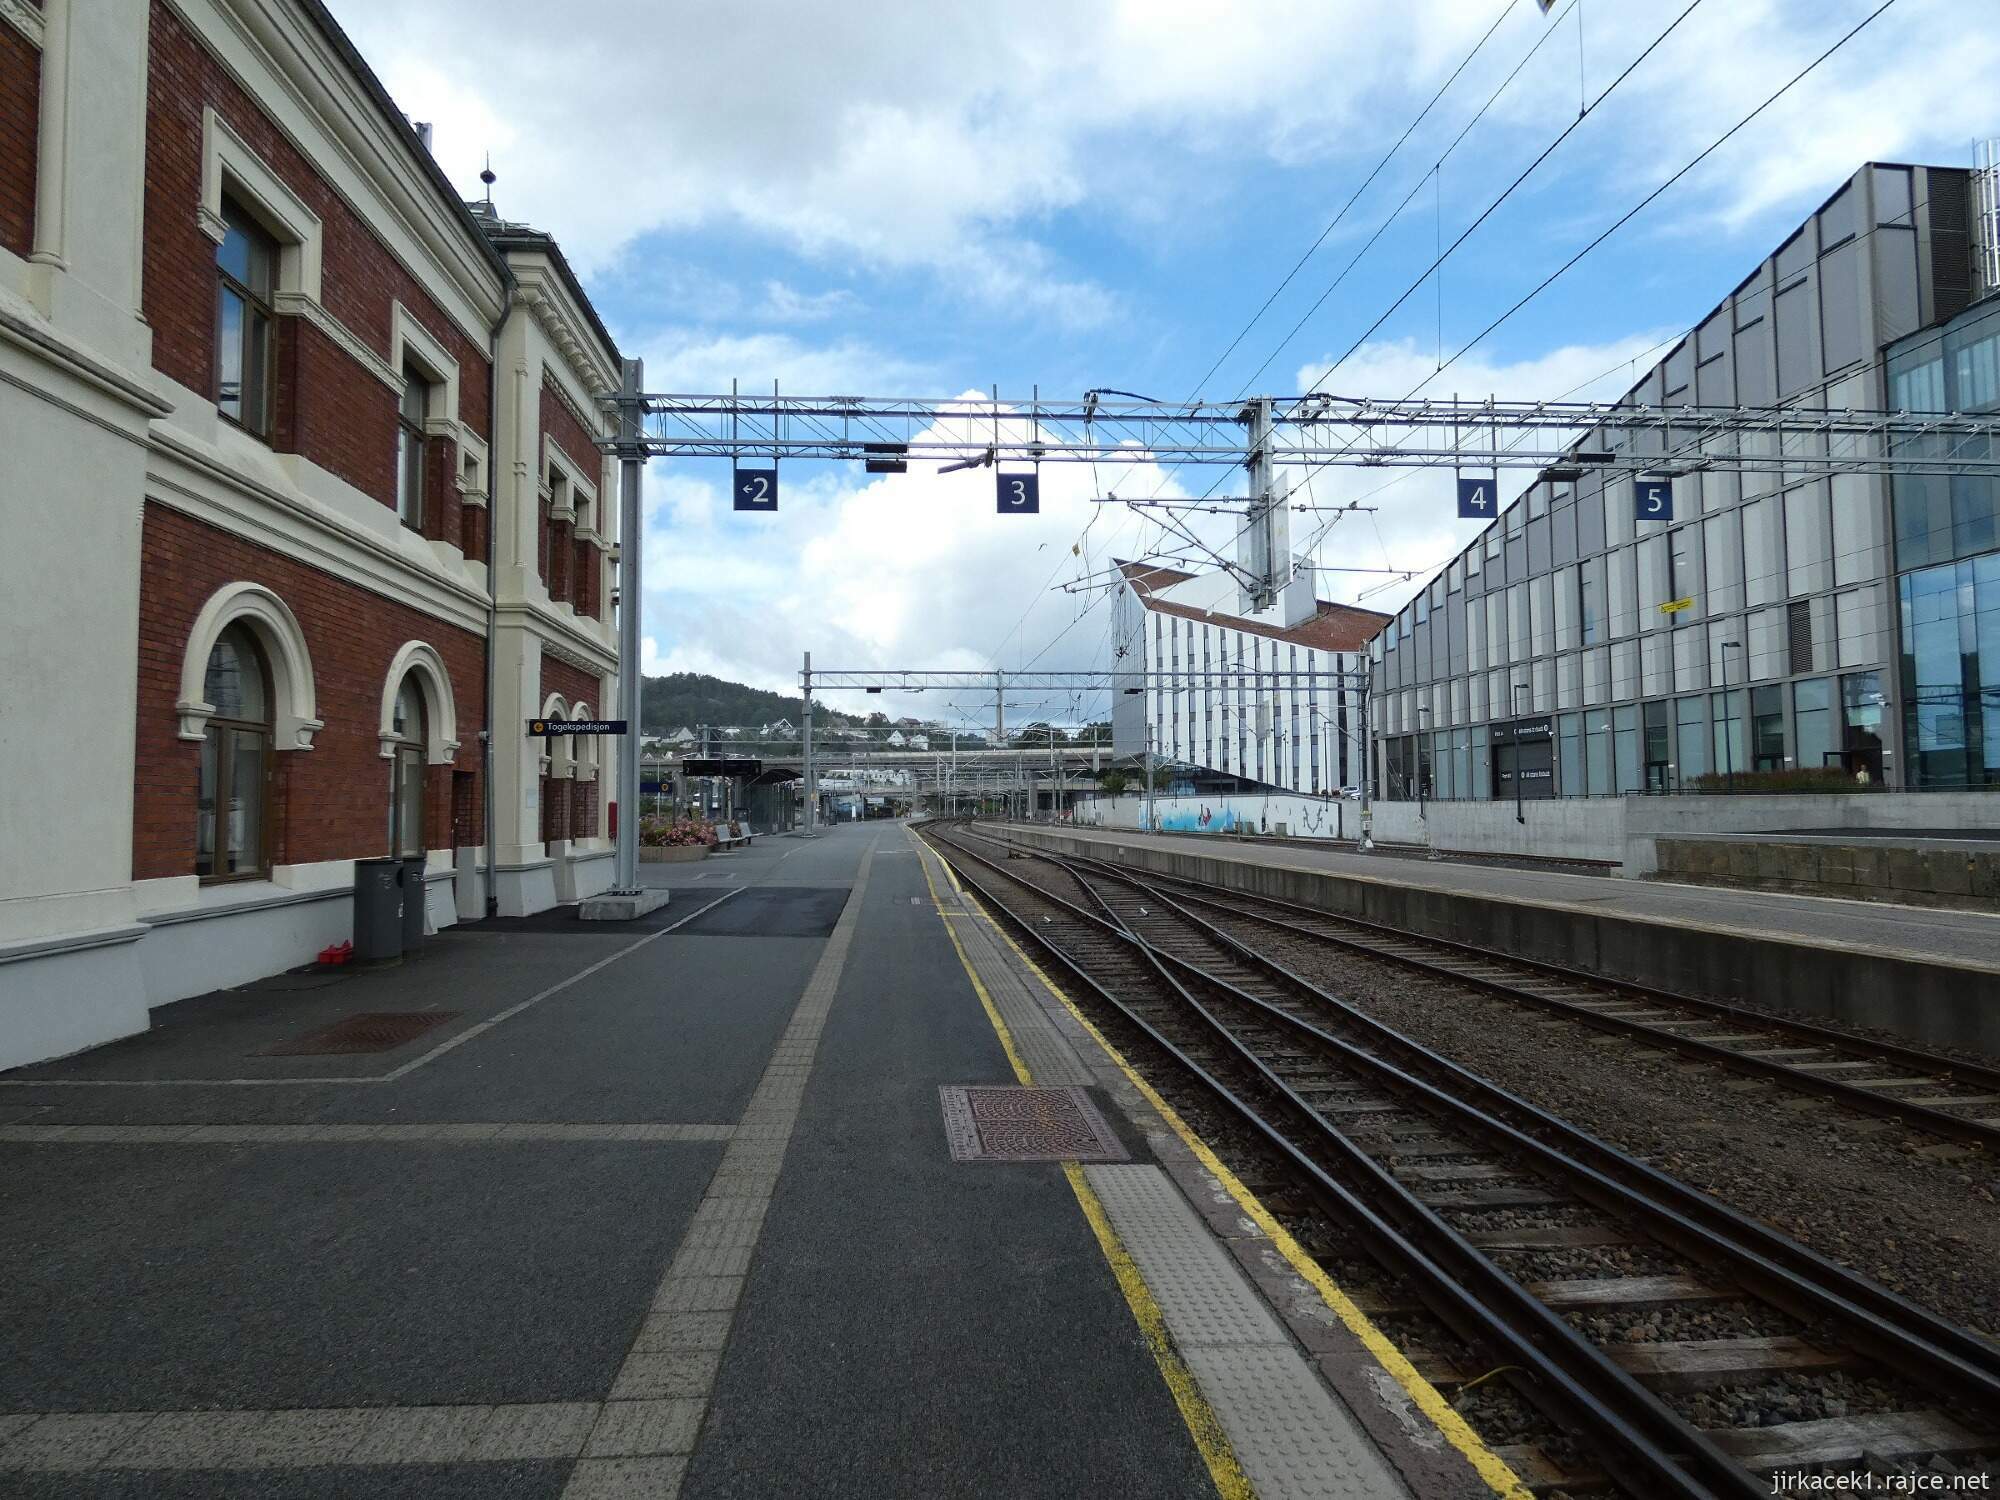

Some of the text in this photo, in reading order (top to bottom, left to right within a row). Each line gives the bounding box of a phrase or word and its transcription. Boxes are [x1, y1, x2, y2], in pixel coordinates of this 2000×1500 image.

[752, 477, 769, 503] 2
[1011, 480, 1026, 505] 3
[1470, 486, 1487, 510] 4
[1647, 488, 1662, 512] 5
[547, 722, 610, 733] Togekspedisjon
